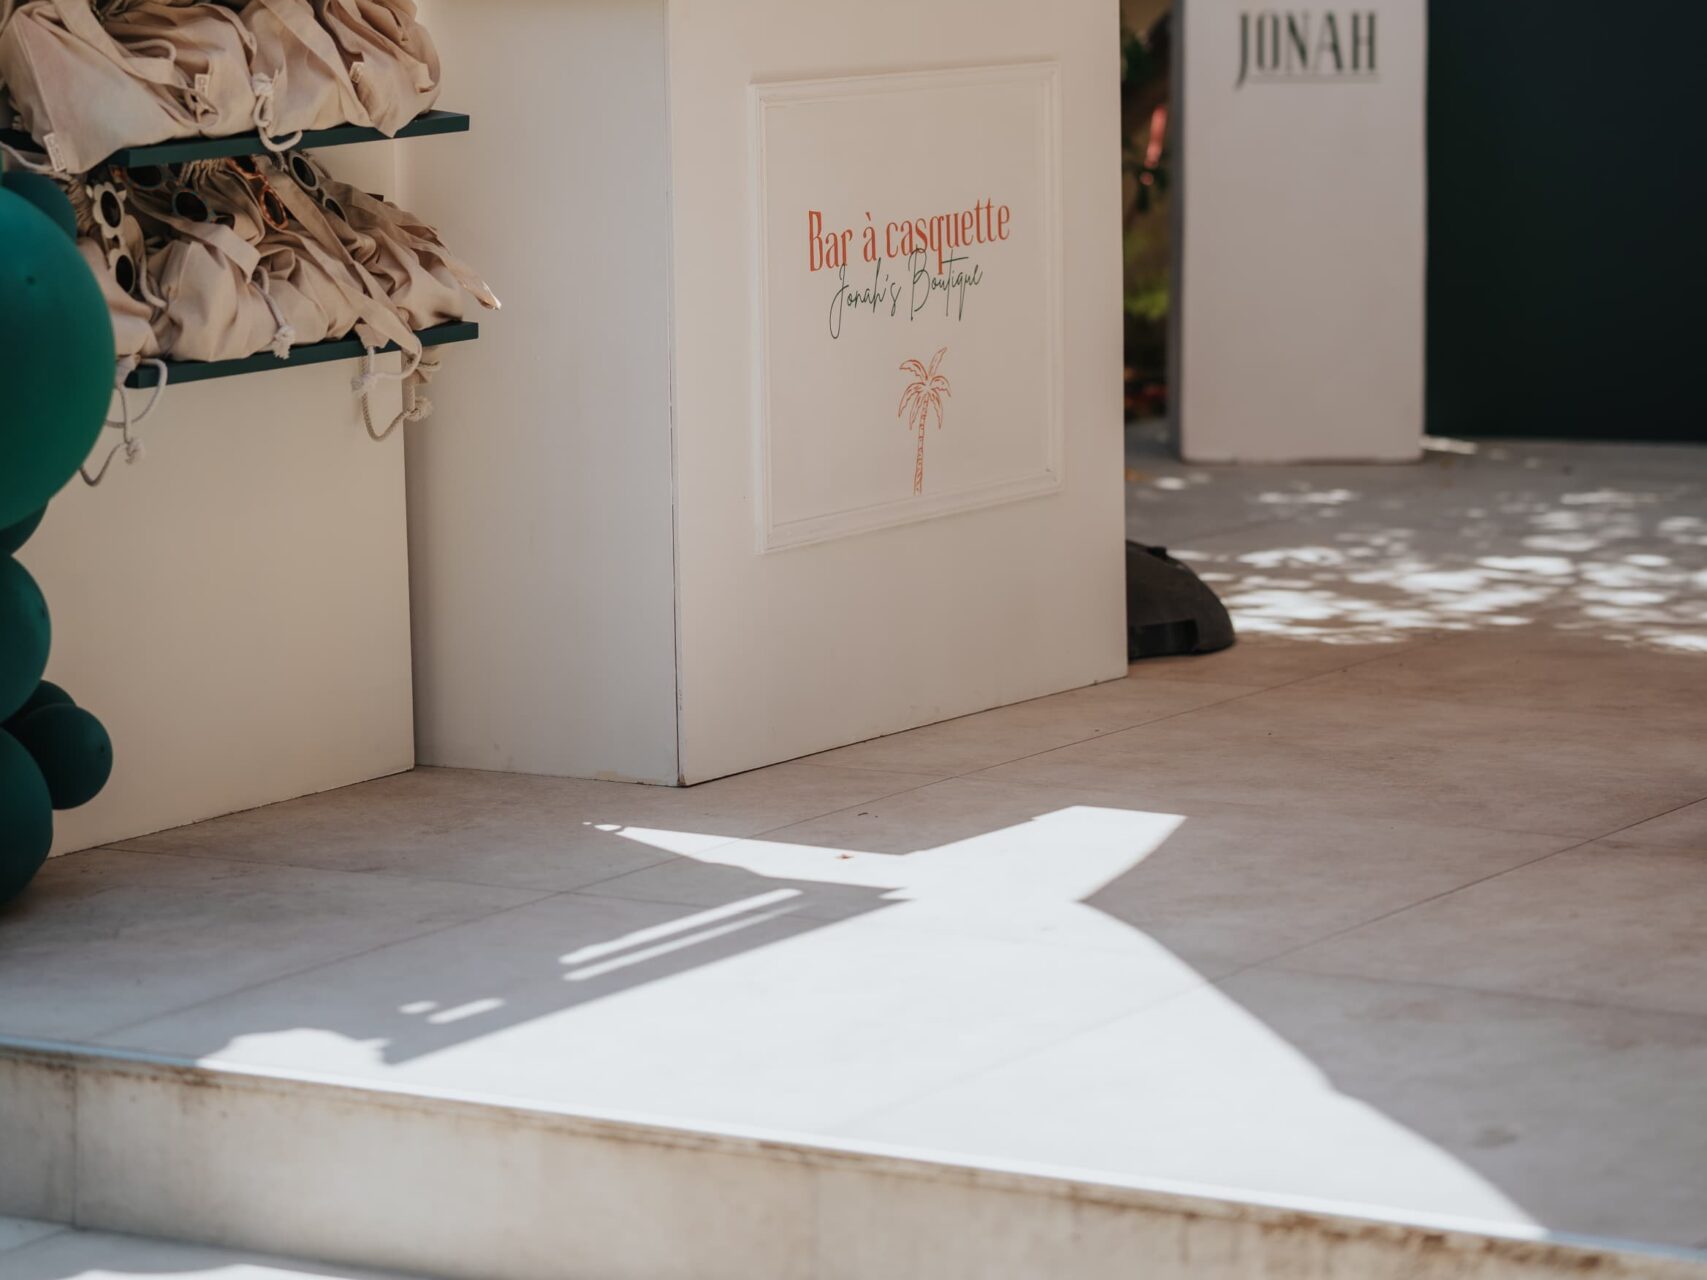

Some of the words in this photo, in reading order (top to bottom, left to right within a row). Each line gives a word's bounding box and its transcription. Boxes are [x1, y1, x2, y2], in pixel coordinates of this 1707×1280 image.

[1236, 11, 1378, 91] JONAH
[808, 210, 853, 272] Bar
[862, 212, 877, 262] à
[886, 198, 1010, 275] casquette
[829, 257, 902, 340] Jonah's
[907, 244, 983, 322] Boutique
